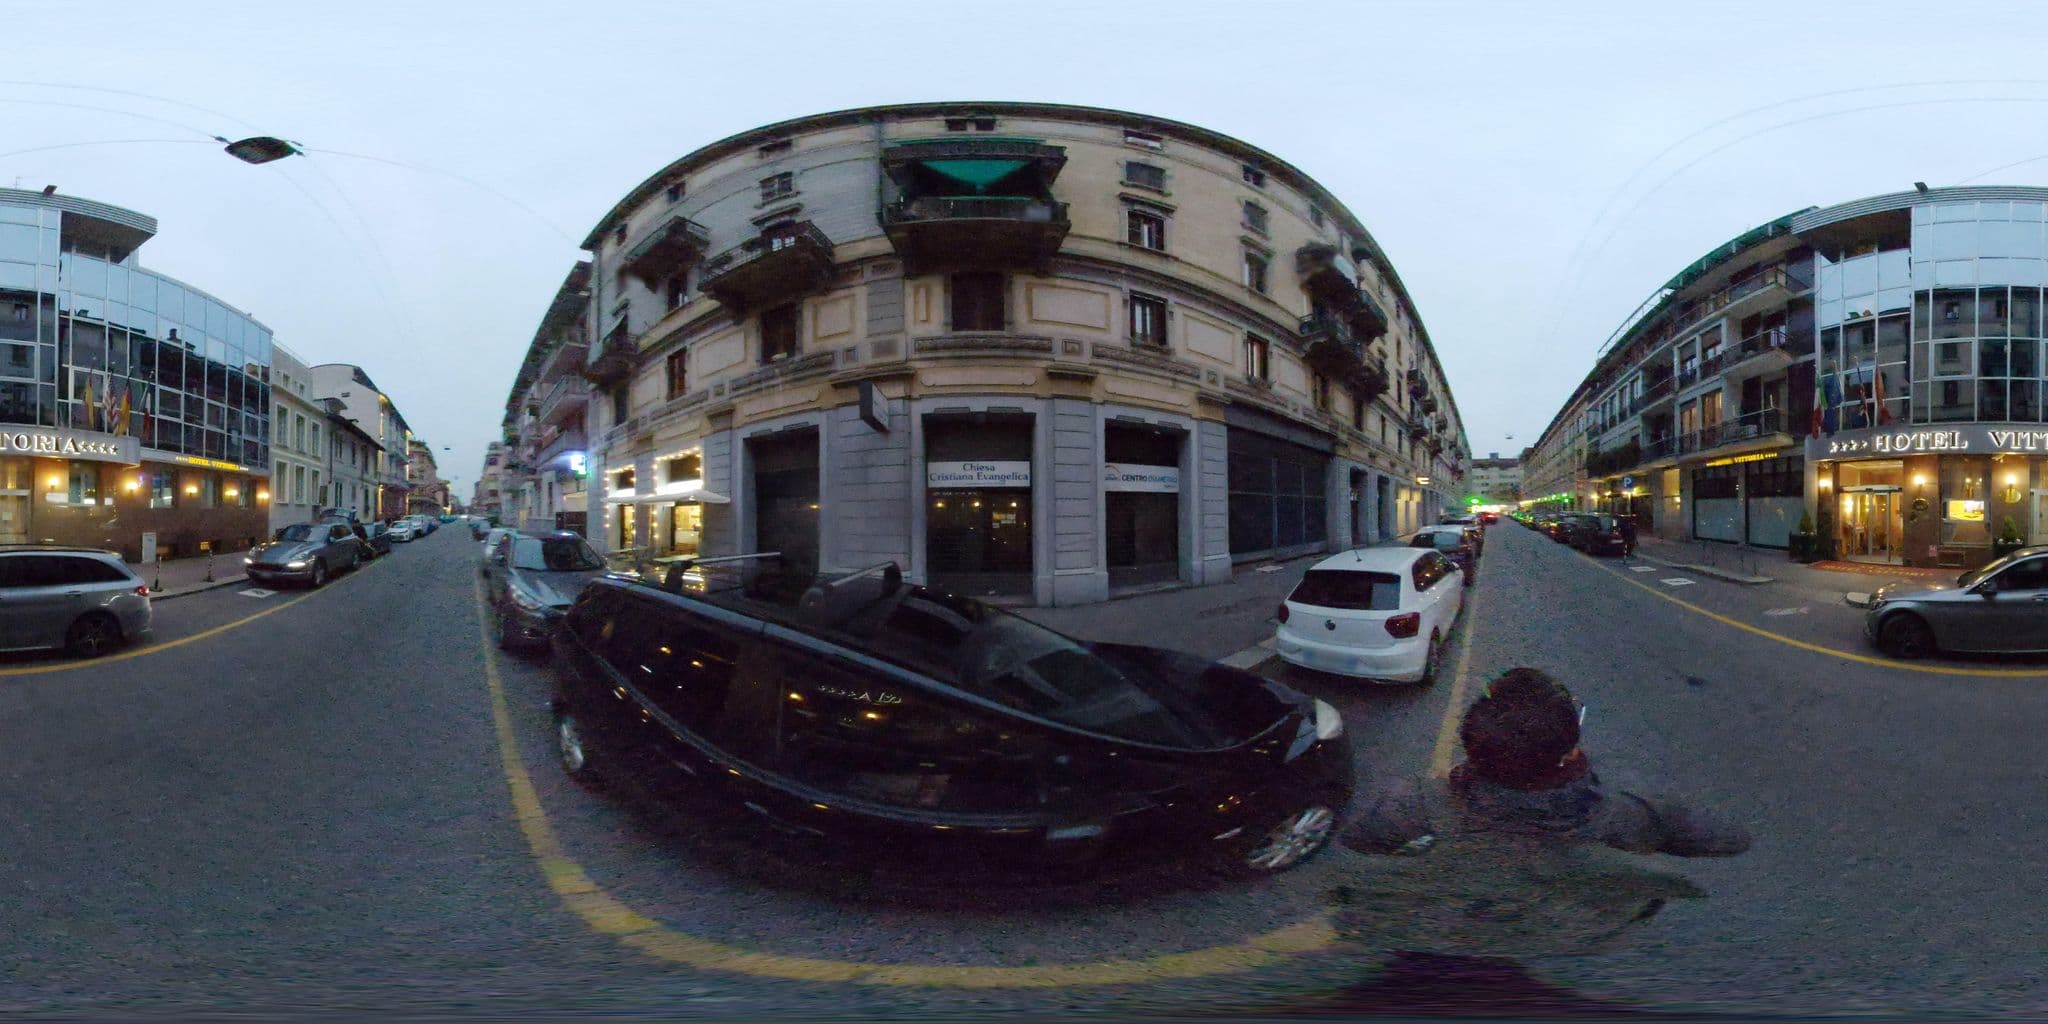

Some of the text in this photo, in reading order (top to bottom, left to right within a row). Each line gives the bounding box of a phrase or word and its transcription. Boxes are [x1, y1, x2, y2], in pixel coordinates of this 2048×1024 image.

[1874, 431, 1969, 452] HOTEL
[962, 463, 996, 472] Chiesa
[929, 472, 1029, 483] Cristiana Evangelica
[1121, 474, 1148, 483] CENTRO
[1623, 477, 1632, 488] P
